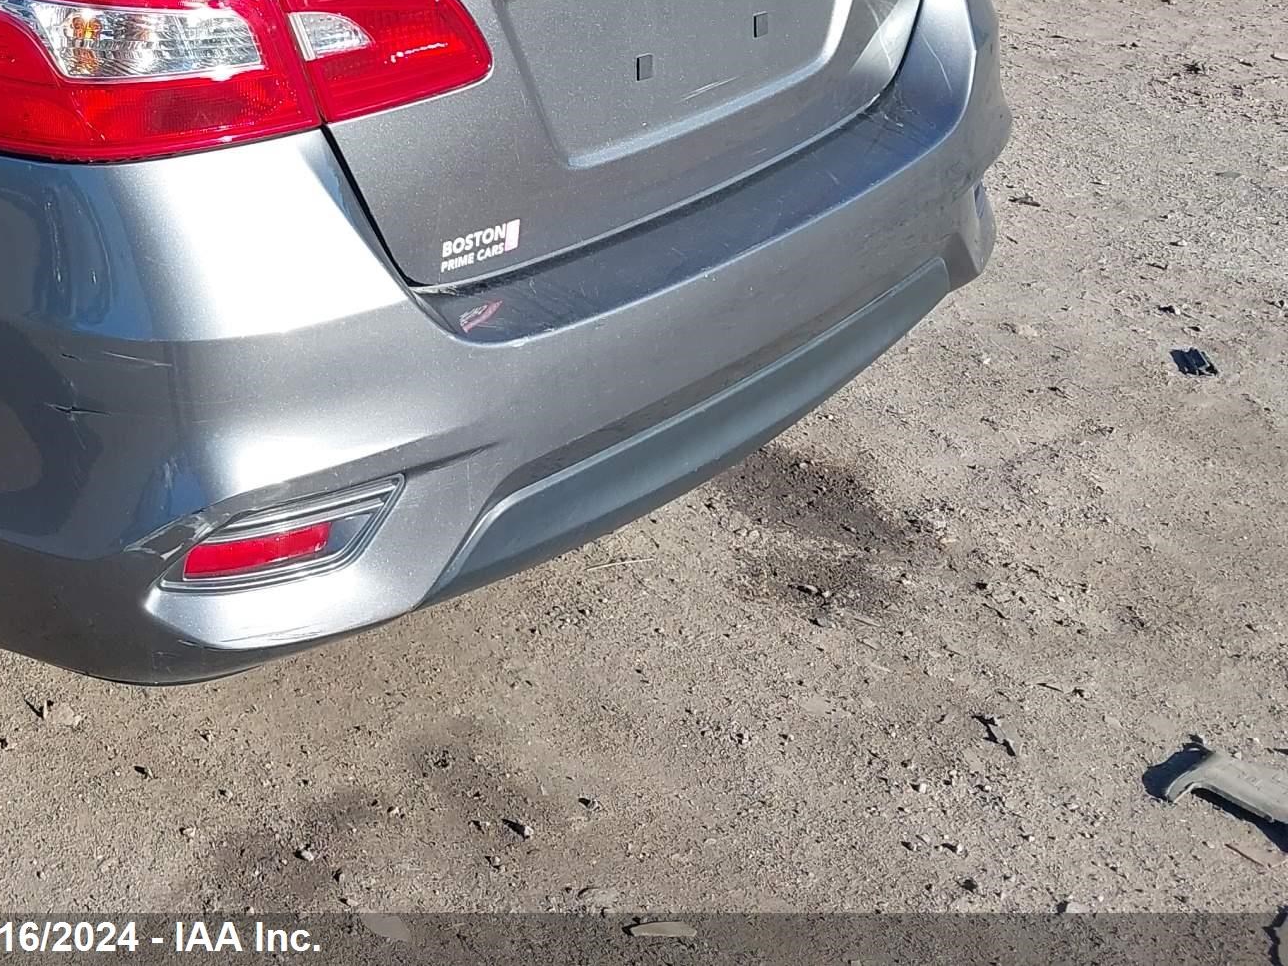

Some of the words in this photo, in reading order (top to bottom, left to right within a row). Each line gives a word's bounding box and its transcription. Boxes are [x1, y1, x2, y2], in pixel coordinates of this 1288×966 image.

[442, 223, 507, 258] BOSTON
[440, 251, 475, 273] PRIME
[476, 242, 505, 262] CARS
